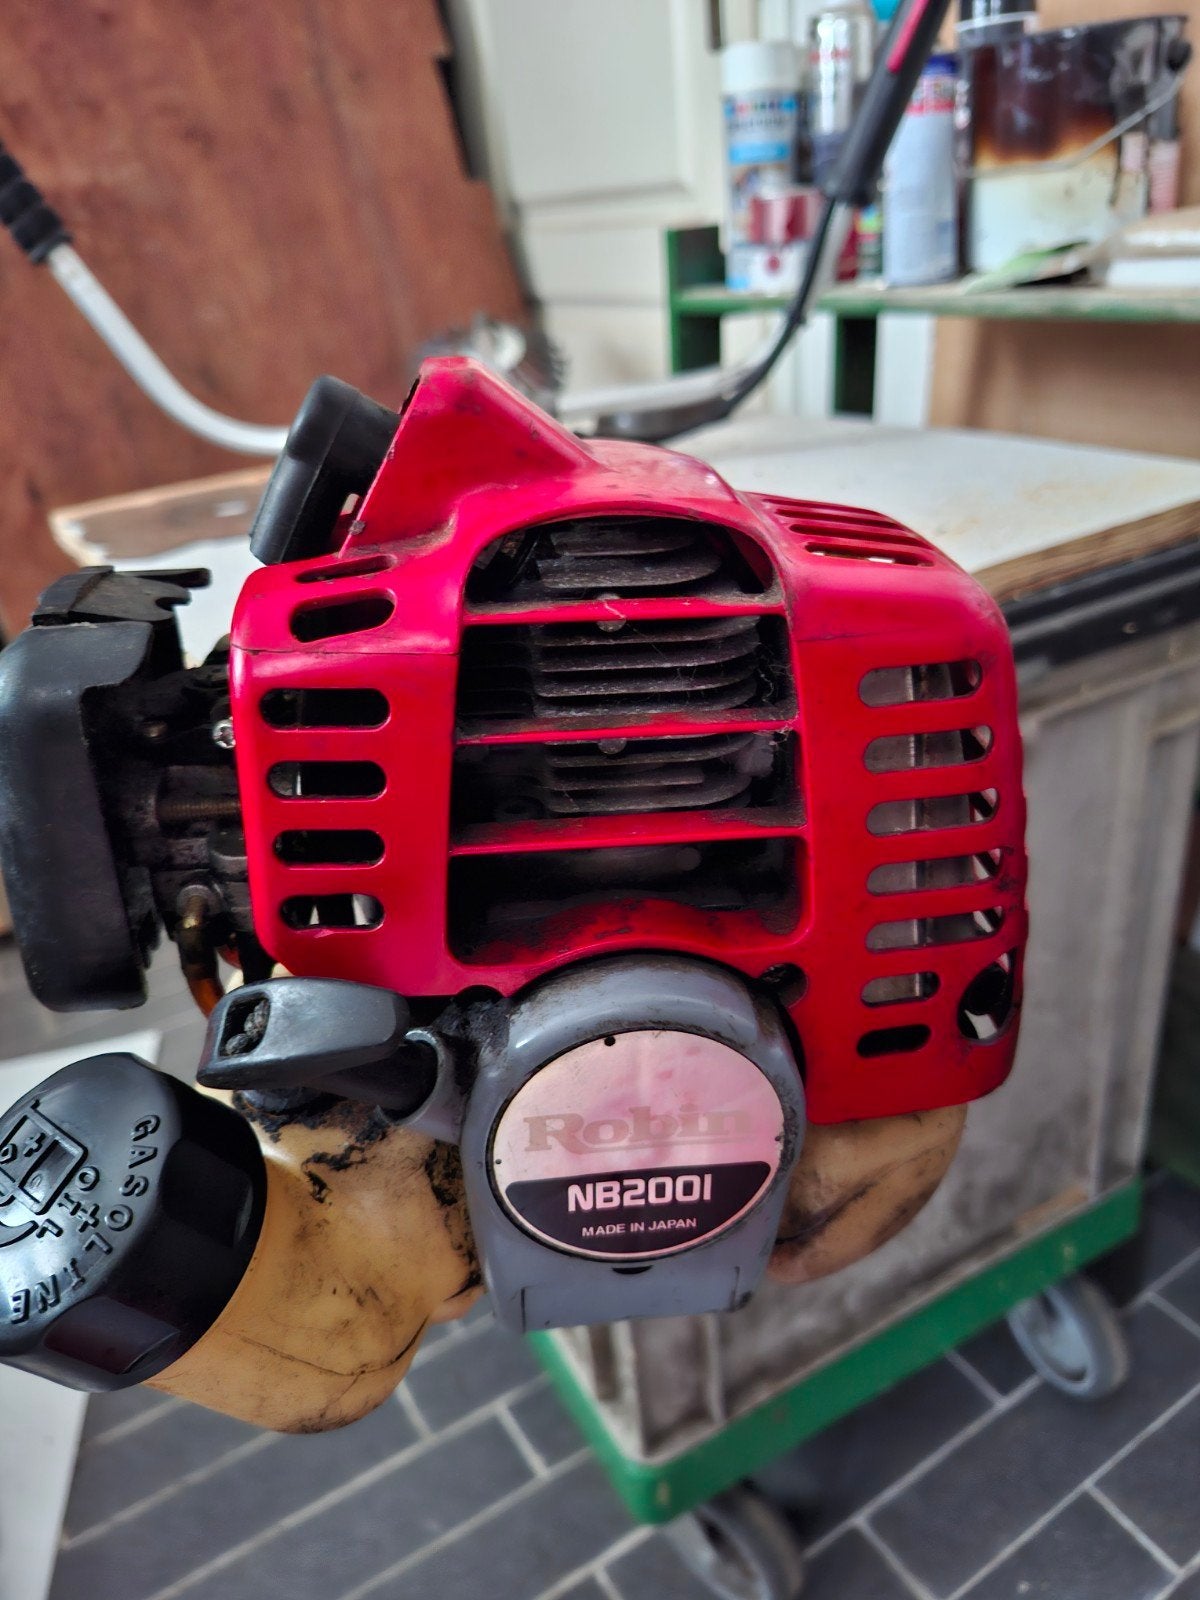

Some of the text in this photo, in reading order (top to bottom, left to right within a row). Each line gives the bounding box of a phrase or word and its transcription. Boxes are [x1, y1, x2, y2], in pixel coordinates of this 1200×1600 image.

[523, 1104, 754, 1155] Robin
[10, 1114, 161, 1324] GASOLINE
[582, 1217, 697, 1237] MADE IN JAPAN
